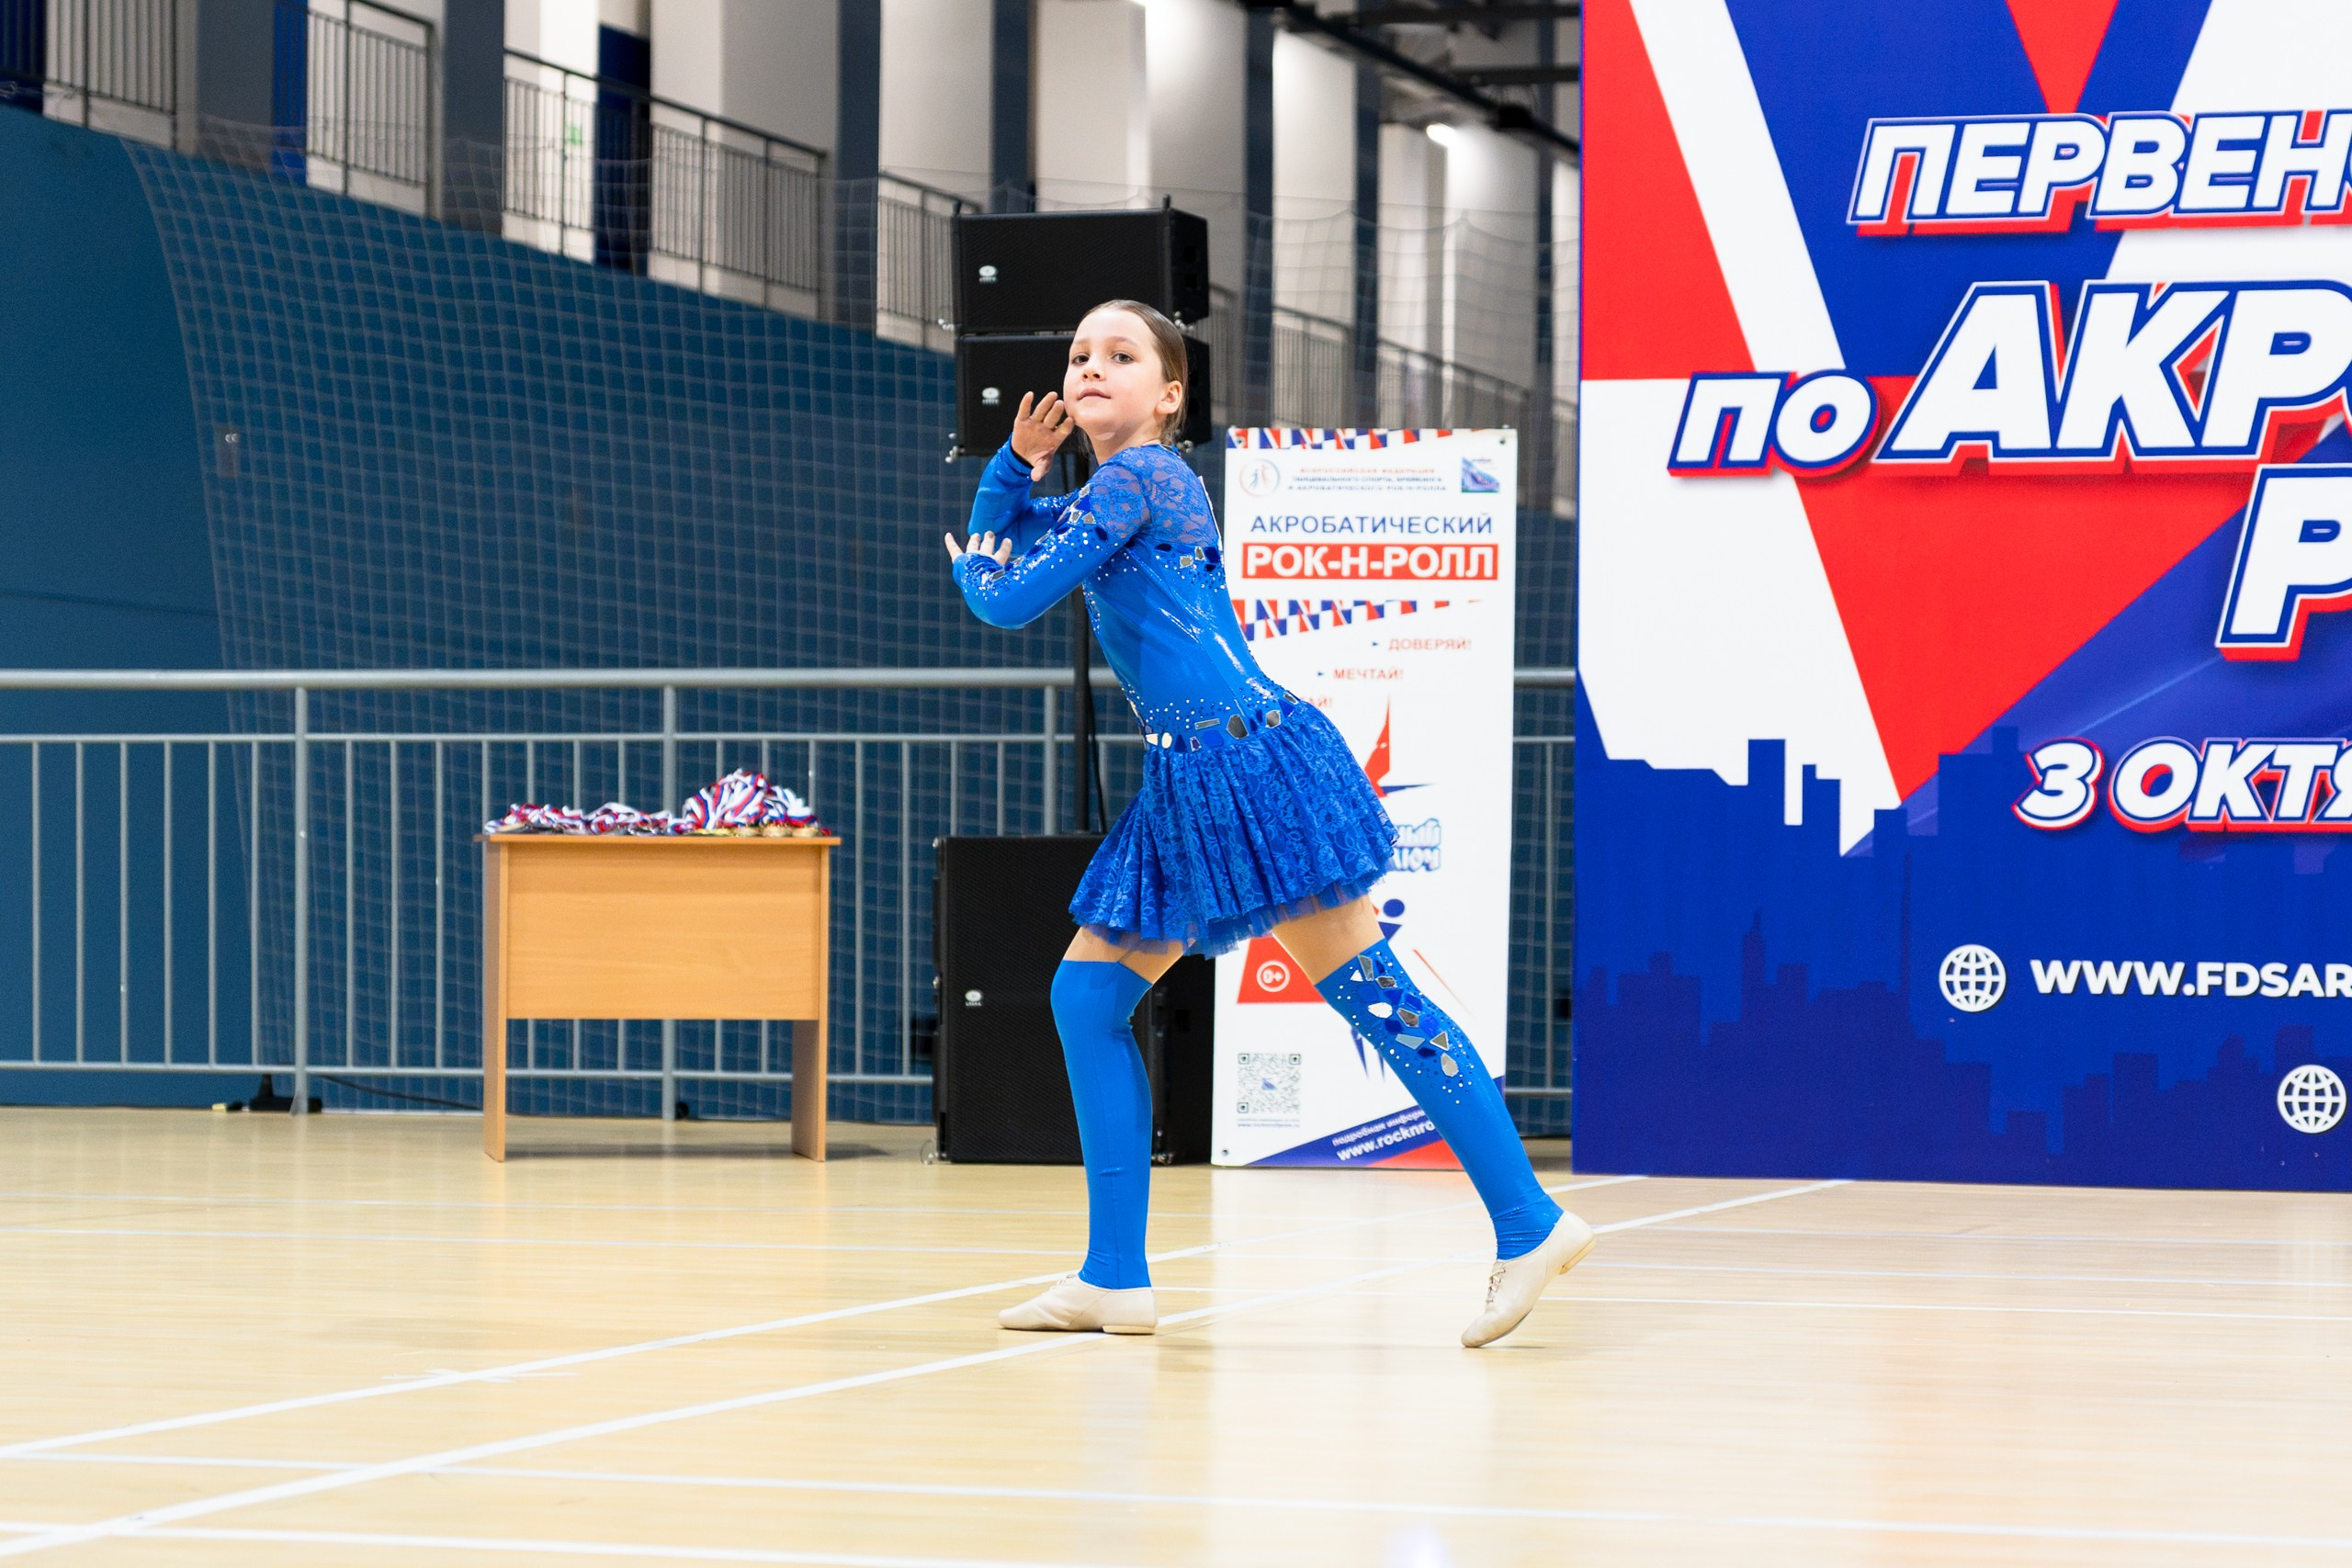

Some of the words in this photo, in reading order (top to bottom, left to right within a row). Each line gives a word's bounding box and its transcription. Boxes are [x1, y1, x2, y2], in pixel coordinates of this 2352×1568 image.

[1849, 111, 2352, 231] ПЕРВЕН
[1250, 512, 1493, 534] АКРОБАТИЧЕСКИЙ
[1246, 546, 1495, 579] РОК-Н-РОЛЛ
[1388, 636, 1472, 651] ДОВЕРЯЙ!
[1333, 666, 1404, 681] МЕЧТАЙ!
[2013, 737, 2104, 830] 3
[2030, 959, 2352, 999] WWW.FDSAR
